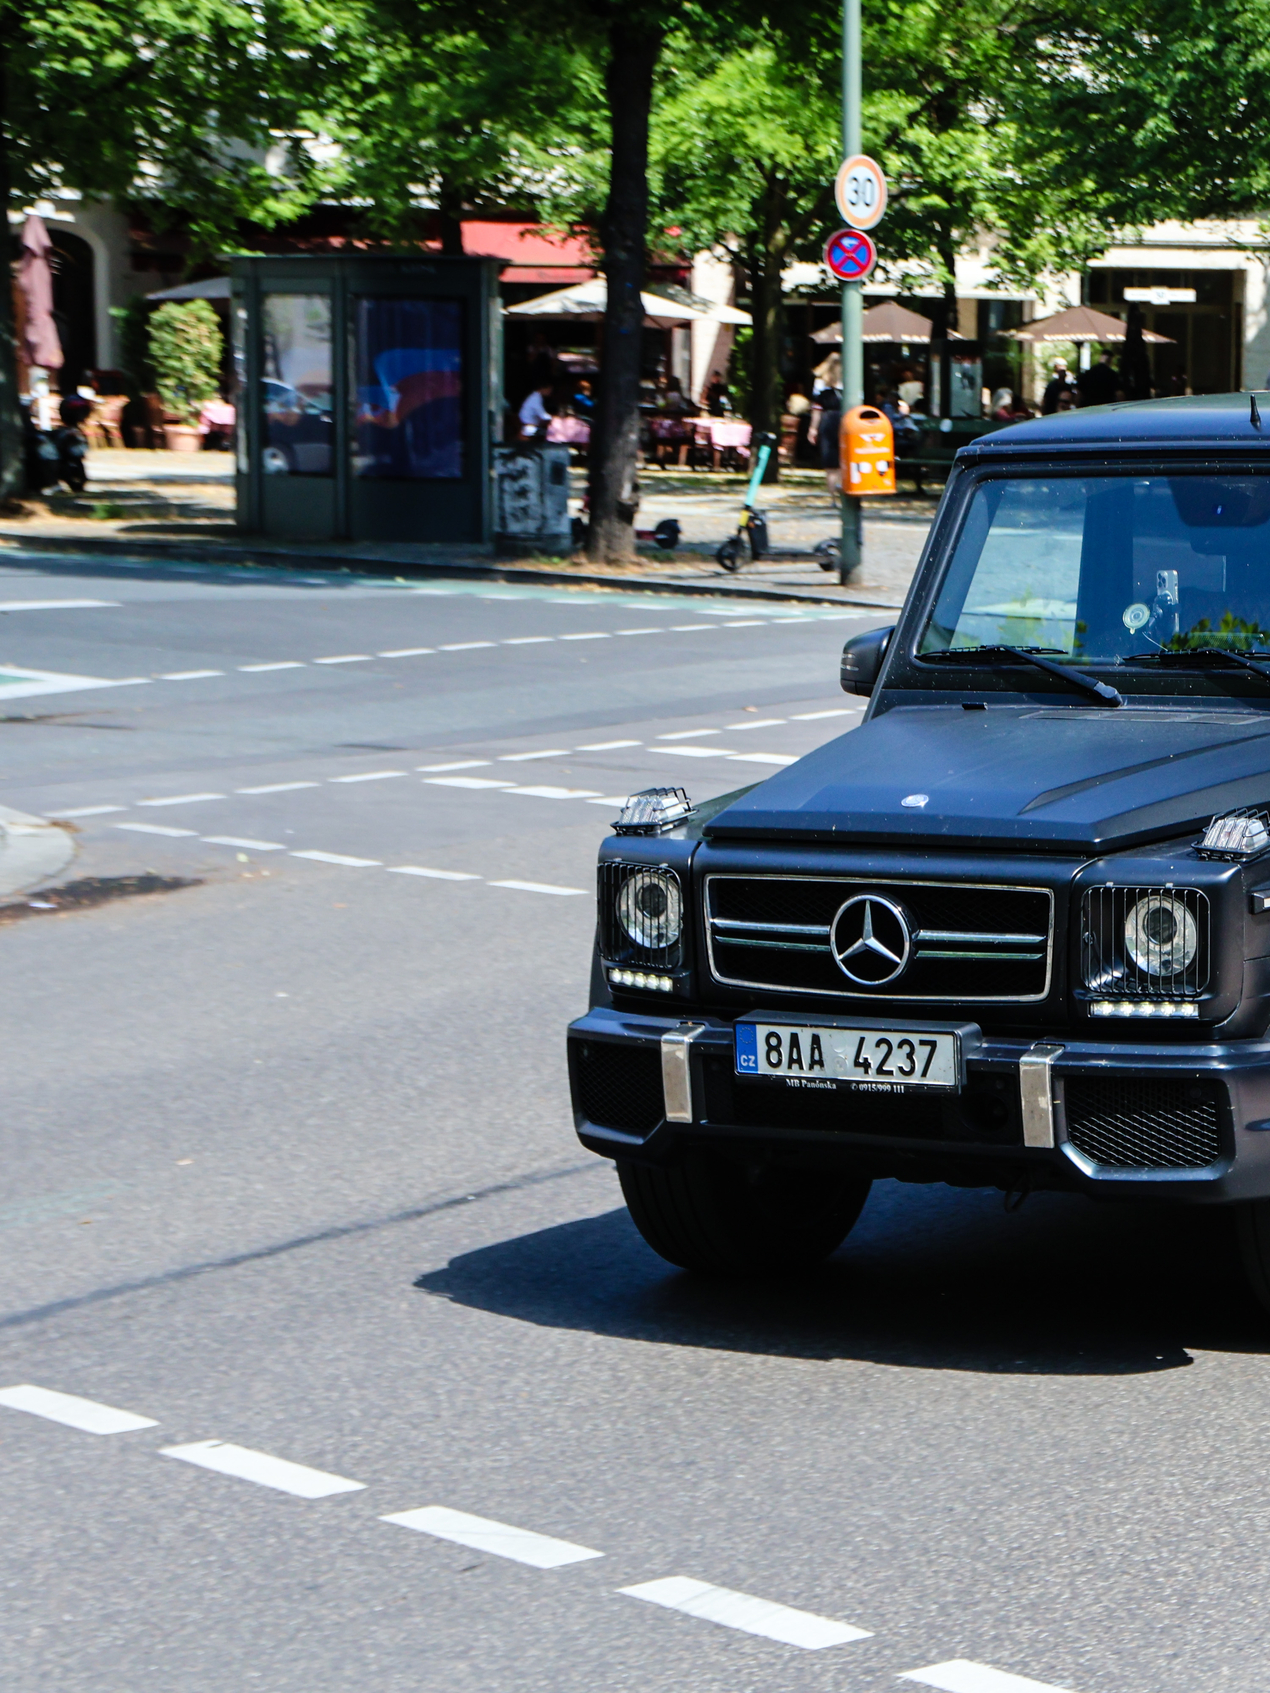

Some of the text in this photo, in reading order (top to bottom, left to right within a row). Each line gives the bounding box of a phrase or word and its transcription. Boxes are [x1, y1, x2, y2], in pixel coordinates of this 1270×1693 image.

[848, 176, 875, 207] 30
[740, 1054, 756, 1068] CZ
[764, 1030, 938, 1079] 8AA 4237
[786, 1078, 800, 1088] MB
